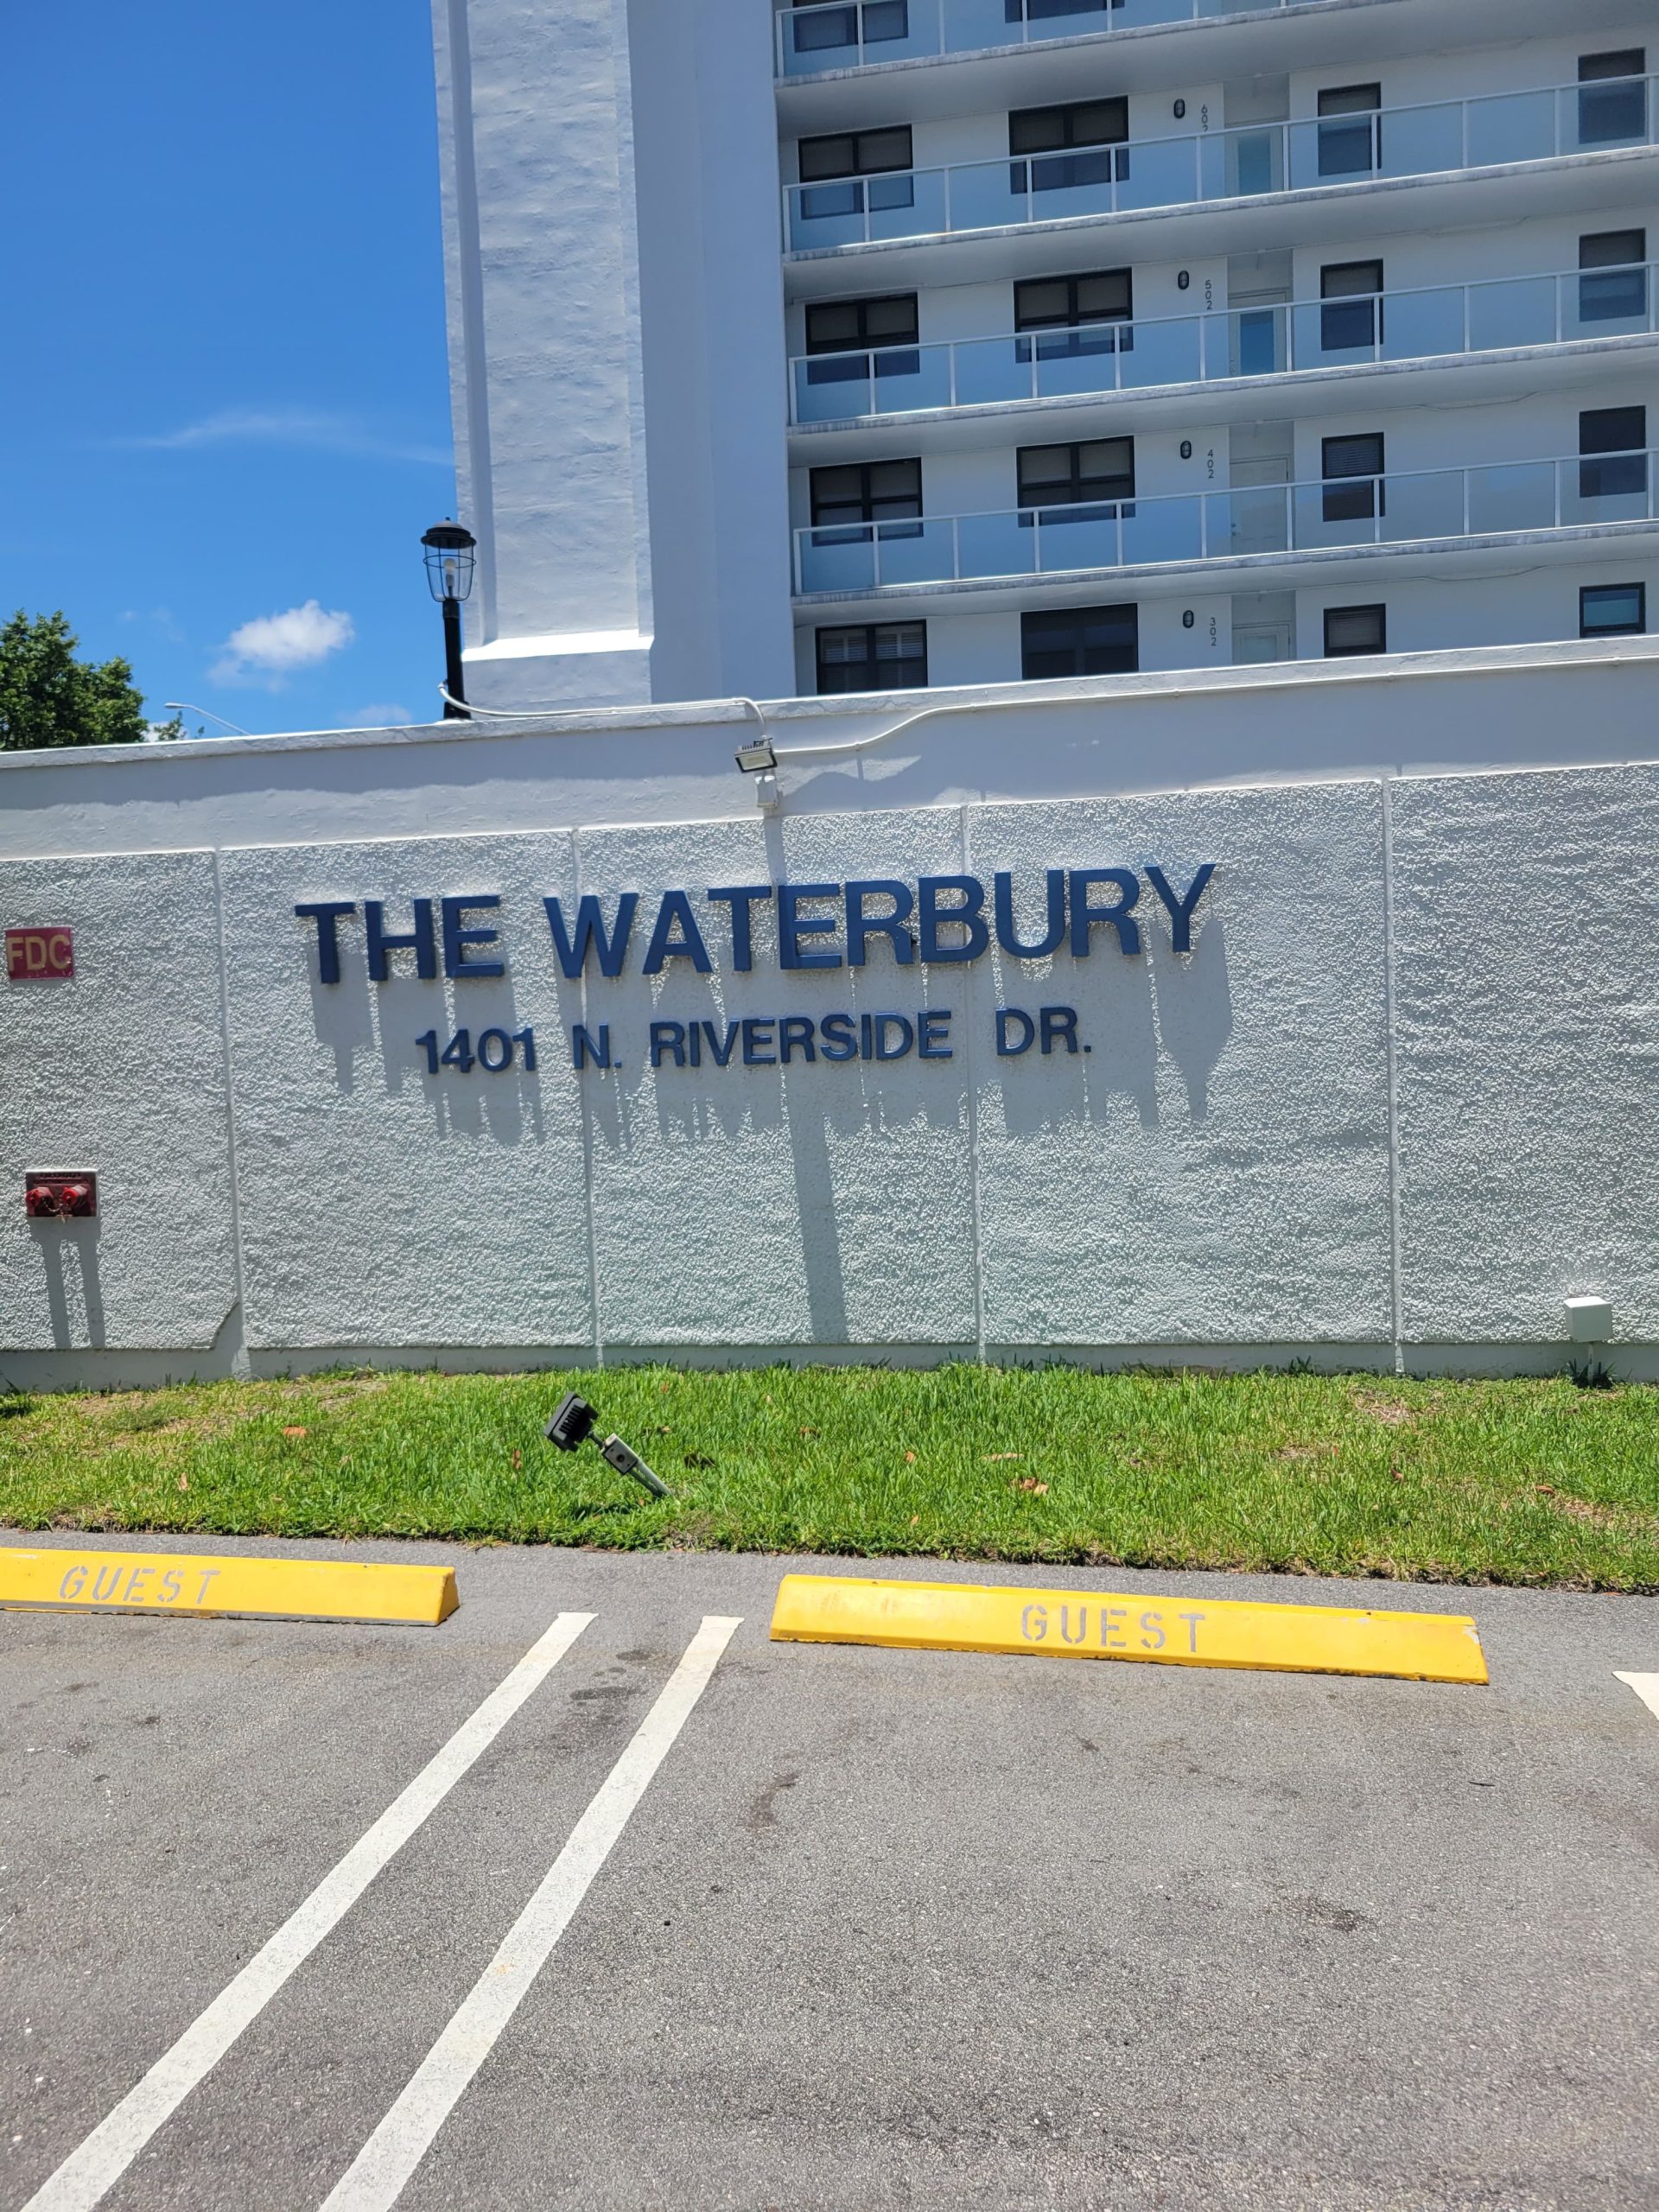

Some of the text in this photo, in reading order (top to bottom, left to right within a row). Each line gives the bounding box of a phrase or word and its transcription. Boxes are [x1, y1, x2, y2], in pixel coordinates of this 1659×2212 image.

[1205, 279, 1213, 310] 502
[295, 864, 1217, 985] THE WATERBURY
[6, 934, 72, 972] FDC
[416, 1007, 1092, 1075] 1401 N. RIVERSIDE DR.
[59, 1565, 221, 1605] GUEST
[1020, 1604, 1205, 1653] GUEST
